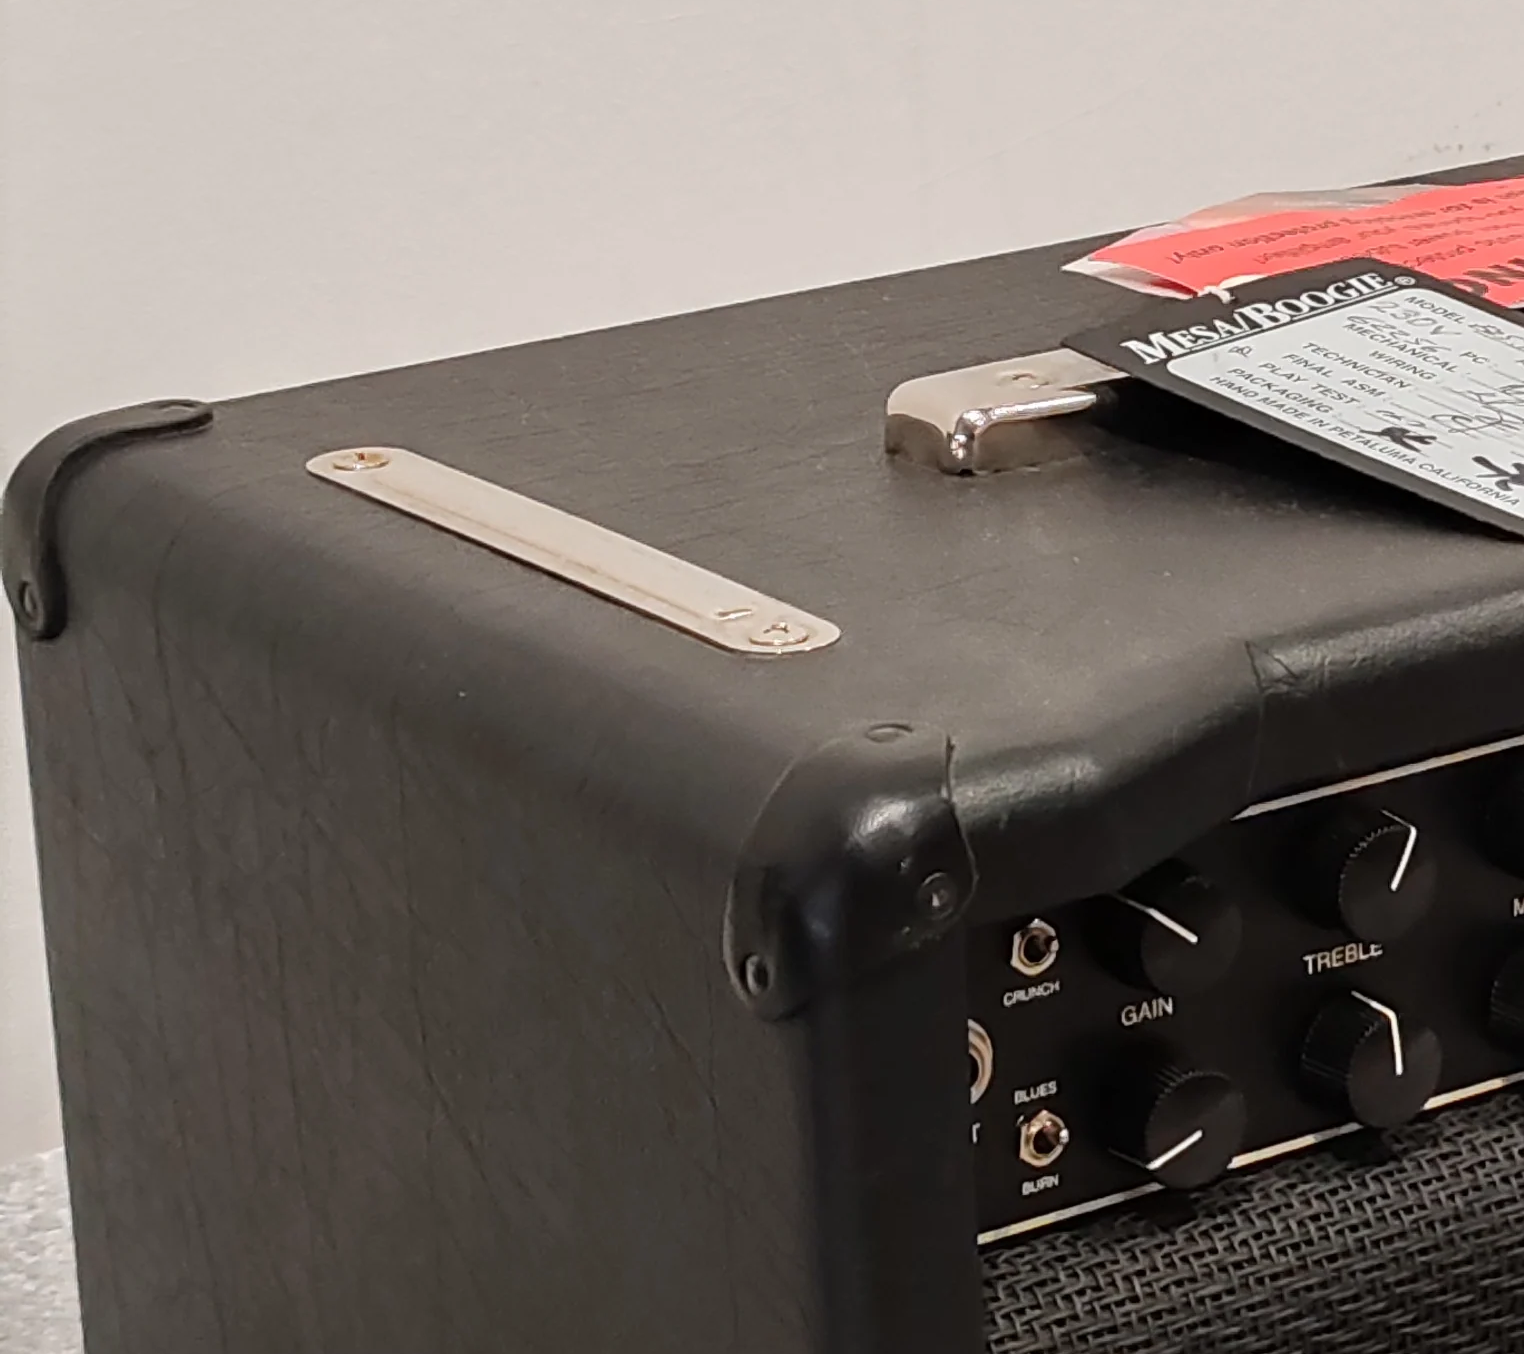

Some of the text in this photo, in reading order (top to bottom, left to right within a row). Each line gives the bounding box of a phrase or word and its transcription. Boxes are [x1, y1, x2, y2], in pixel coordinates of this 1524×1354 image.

[1404, 296, 1467, 324] MODEL
[1344, 323, 1460, 374] MECHANICAL
[1369, 351, 1438, 380] WIRING
[1227, 367, 1333, 414] PACKAGING
[1259, 362, 1362, 405] PLAY TEST
[1282, 353, 1387, 399] FINAL ASM
[1210, 375, 1259, 399] HAND
[1259, 398, 1308, 420] MADE
[1328, 425, 1416, 466] PETALUMA
[1418, 462, 1524, 508] CALIFORNIA
[1303, 942, 1384, 977] TREBLE
[1002, 979, 1061, 1008] CRUNCH
[1120, 995, 1175, 1028] GAIN
[1014, 1080, 1058, 1106] BLUES
[1021, 1173, 1060, 1196] BURN
